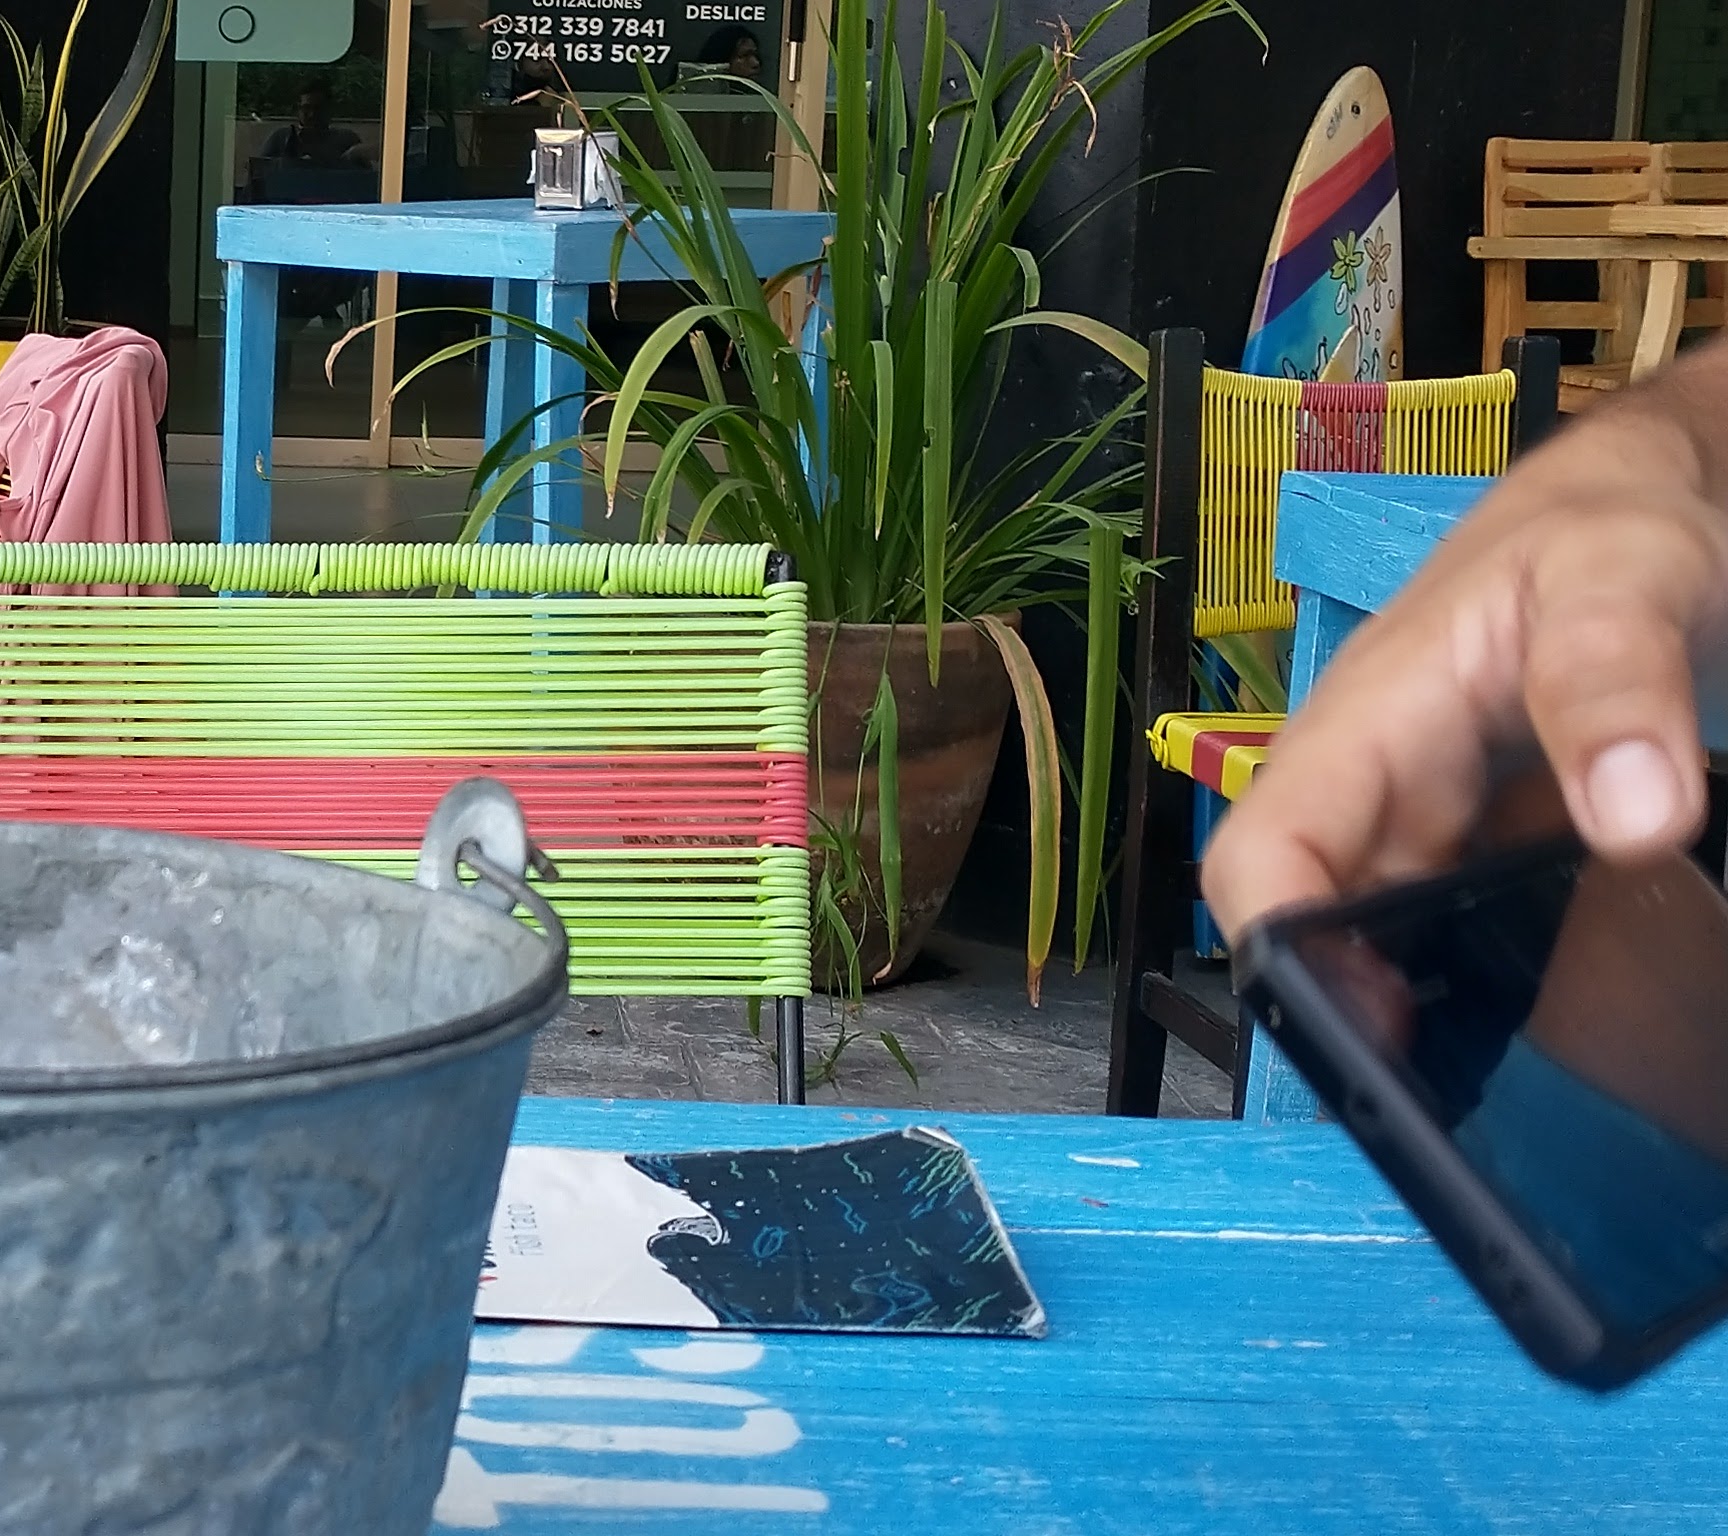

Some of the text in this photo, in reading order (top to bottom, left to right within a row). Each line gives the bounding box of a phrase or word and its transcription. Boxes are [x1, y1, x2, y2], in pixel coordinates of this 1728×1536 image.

[686, 5, 765, 21] DESLICE
[513, 16, 665, 38] 312 339 7841
[513, 42, 671, 64] 744 163 5027
